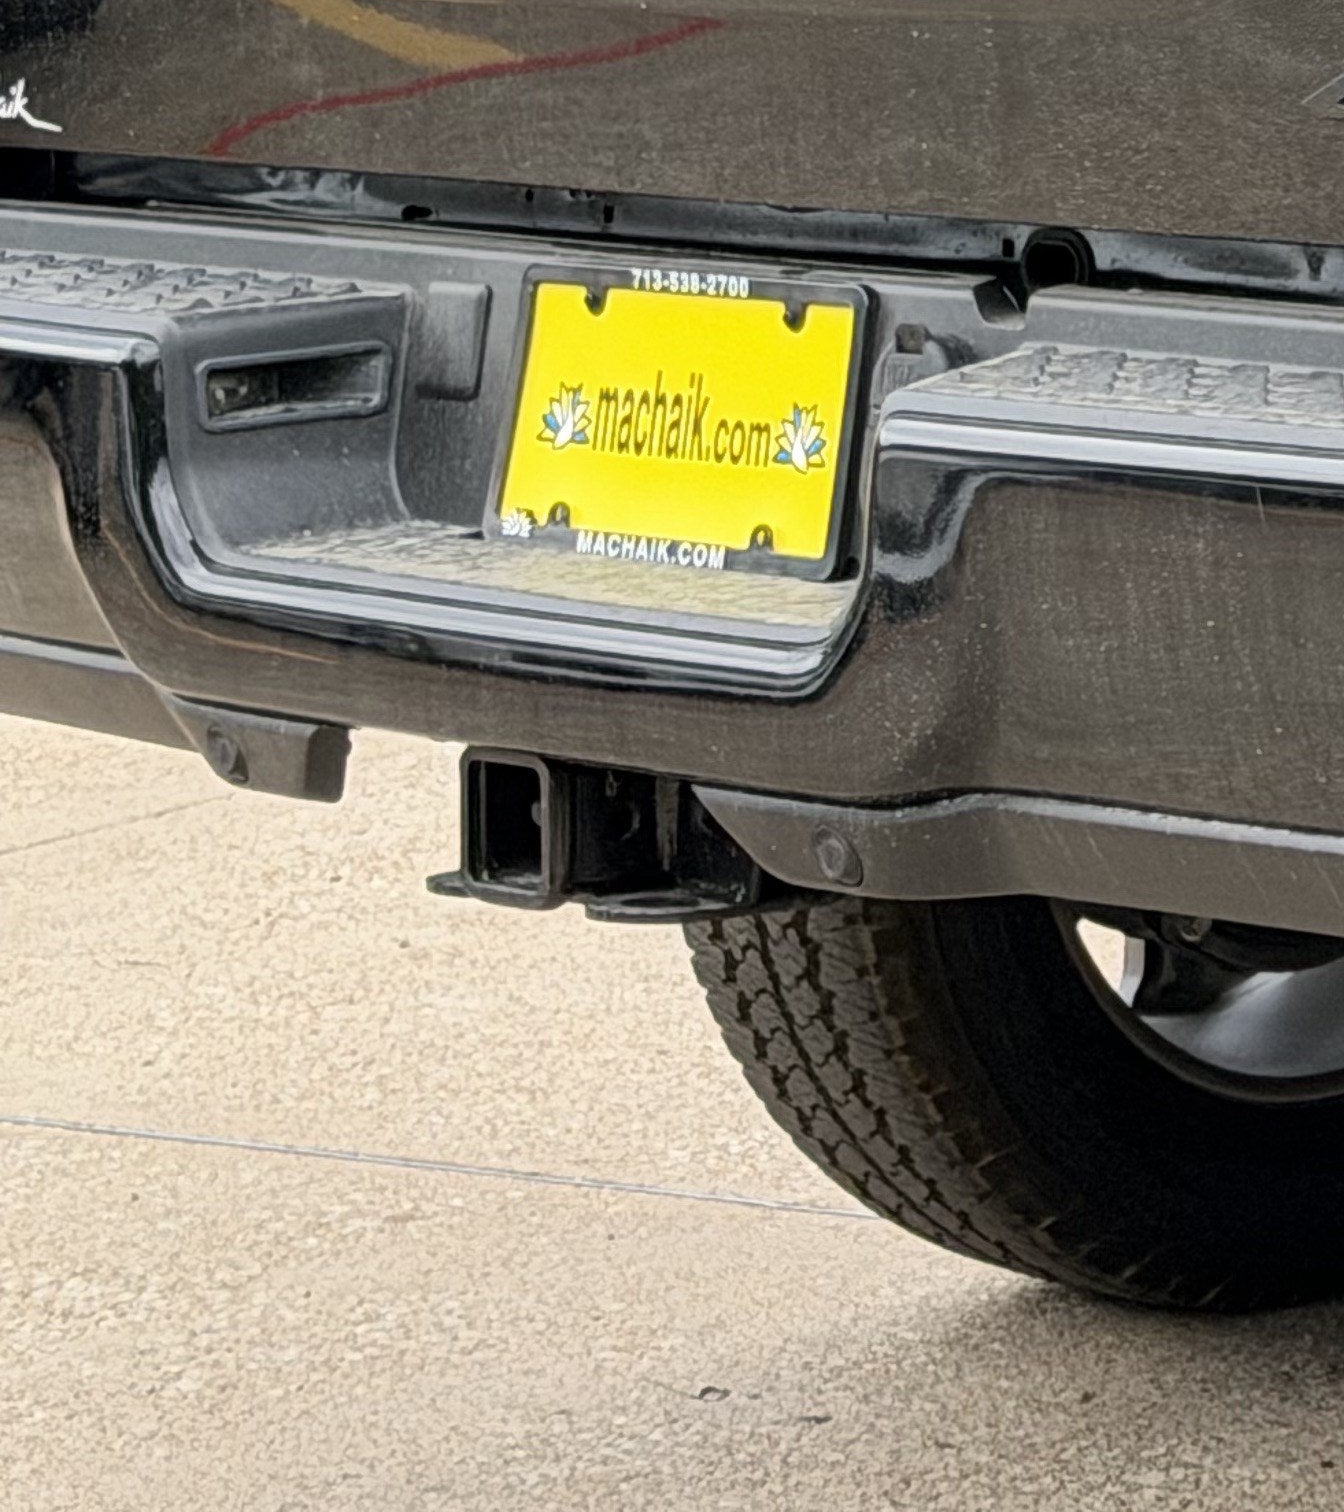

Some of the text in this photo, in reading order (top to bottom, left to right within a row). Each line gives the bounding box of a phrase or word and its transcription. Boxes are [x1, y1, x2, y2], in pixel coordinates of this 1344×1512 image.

[631, 268, 749, 298] 713-538-2700
[592, 371, 771, 466] machaik.com
[576, 530, 726, 569] MACHAIK.COM
